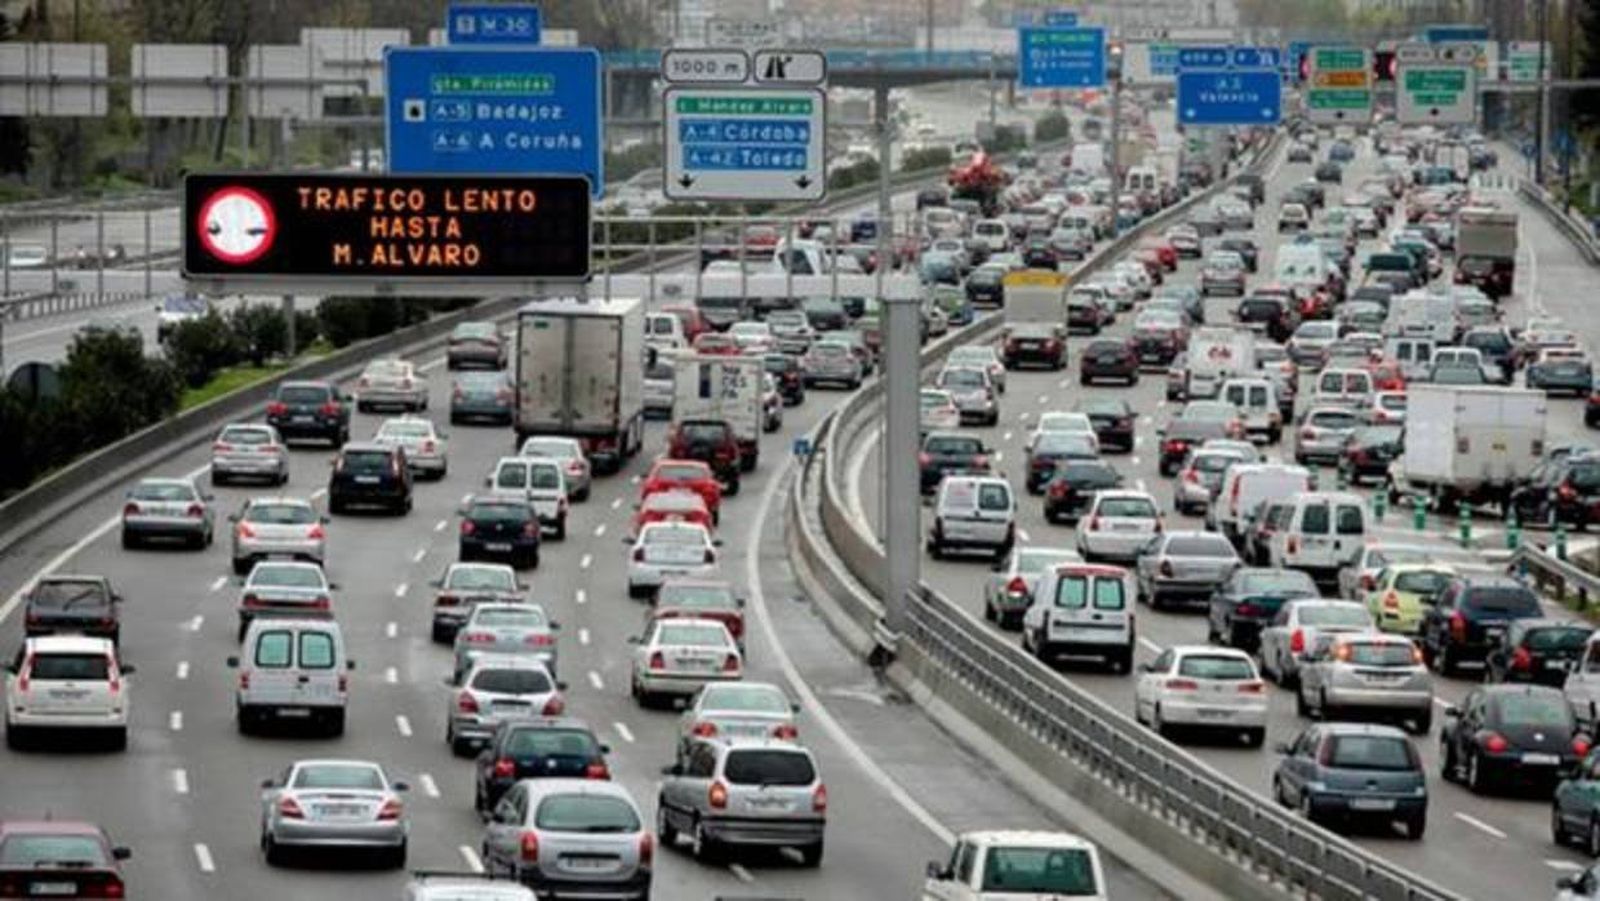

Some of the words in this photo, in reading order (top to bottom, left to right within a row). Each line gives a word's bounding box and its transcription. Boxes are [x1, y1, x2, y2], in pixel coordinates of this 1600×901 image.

[673, 61, 718, 74] 1000
[724, 63, 739, 73] m
[476, 103, 564, 122] Badajoz
[723, 123, 808, 139] Córdoba
[479, 133, 494, 149] A
[504, 132, 583, 149] Coruña
[741, 150, 806, 167] Toledo
[298, 187, 425, 211] TRAFICO
[444, 189, 536, 212] LENTO
[370, 216, 462, 239] HASTA
[333, 244, 481, 266] M.ALVARO
